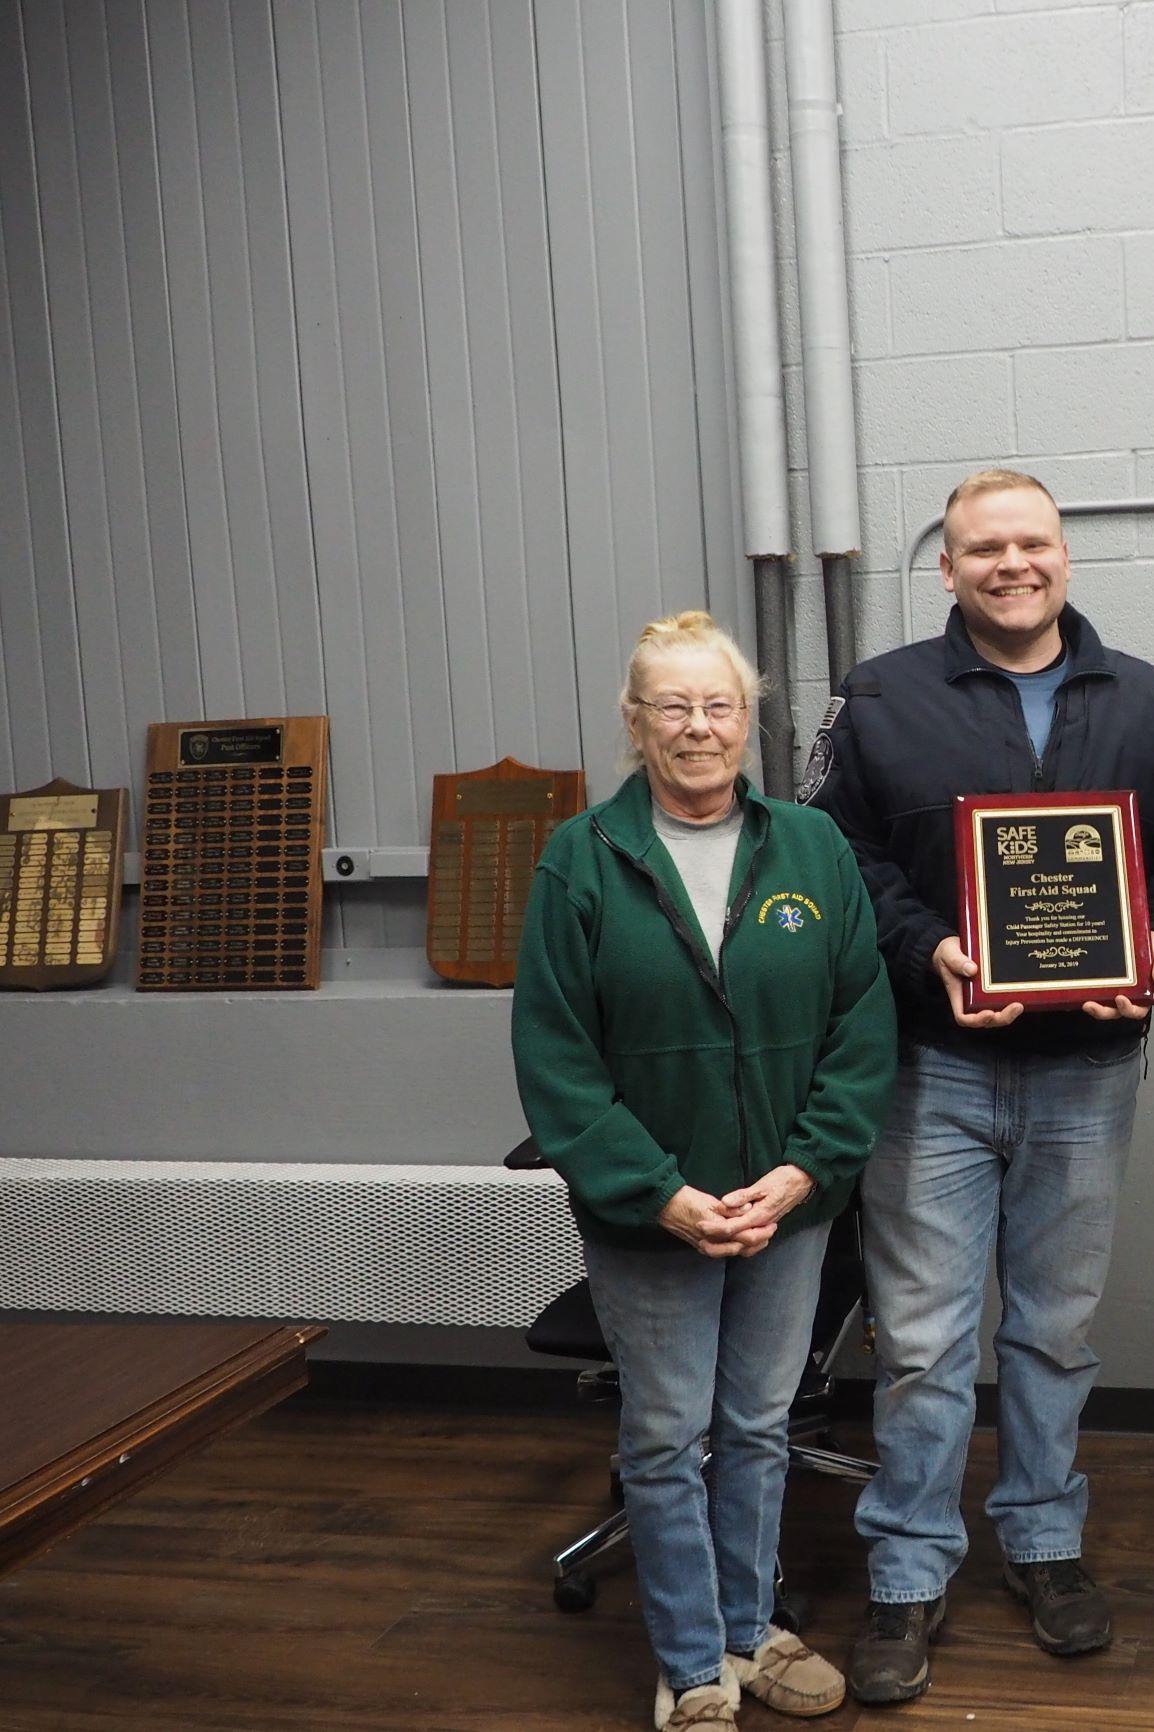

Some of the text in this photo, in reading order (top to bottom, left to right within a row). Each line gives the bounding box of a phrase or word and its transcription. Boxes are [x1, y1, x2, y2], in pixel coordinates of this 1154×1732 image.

[997, 826, 1037, 840] SAFE
[1031, 874, 1074, 883] Chester
[1010, 884, 1097, 897] First Aid Squad
[758, 892, 822, 924] CHESTER FIRST AID SQUAD
